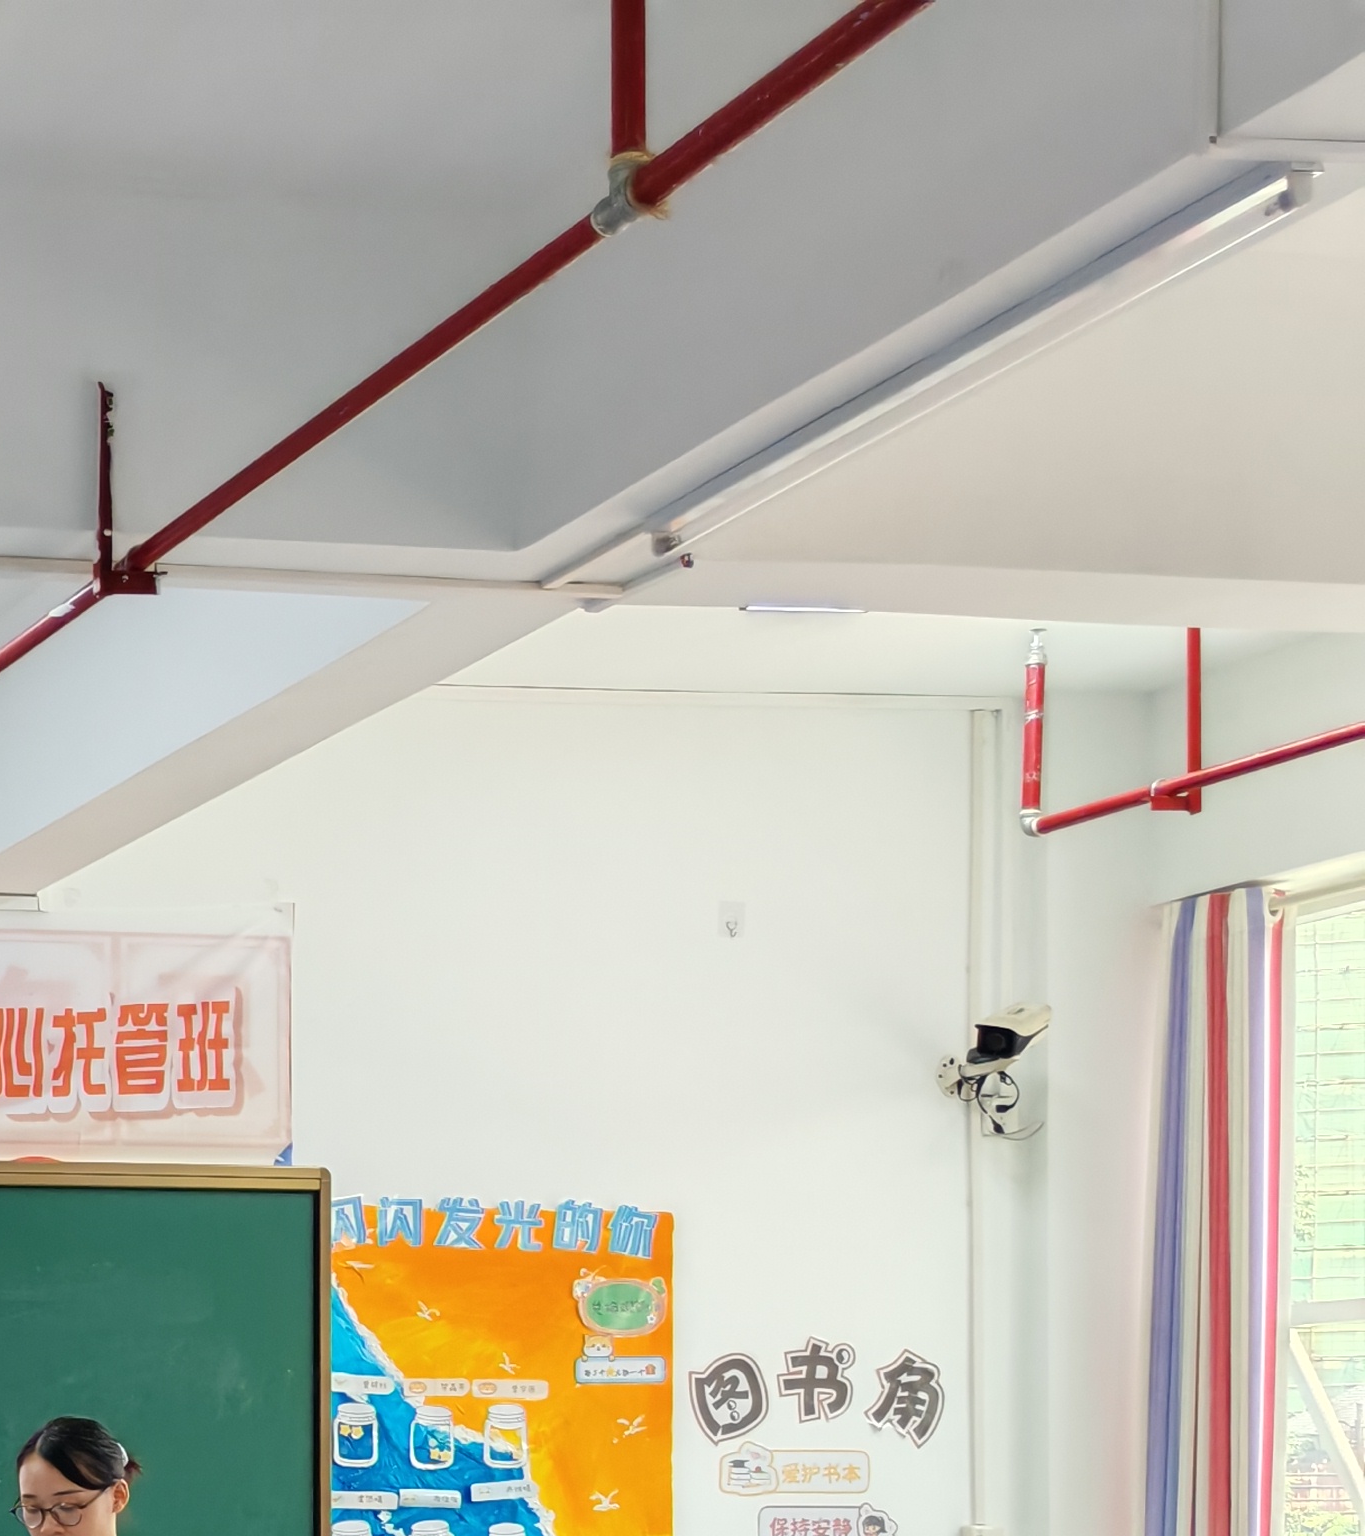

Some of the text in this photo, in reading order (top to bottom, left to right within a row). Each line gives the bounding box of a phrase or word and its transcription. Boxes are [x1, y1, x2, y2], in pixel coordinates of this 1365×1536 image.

[332, 1195, 658, 1259] 闪闪发光的你
[689, 1337, 944, 1447] 图书角
[781, 1463, 862, 1484] 爱护书本
